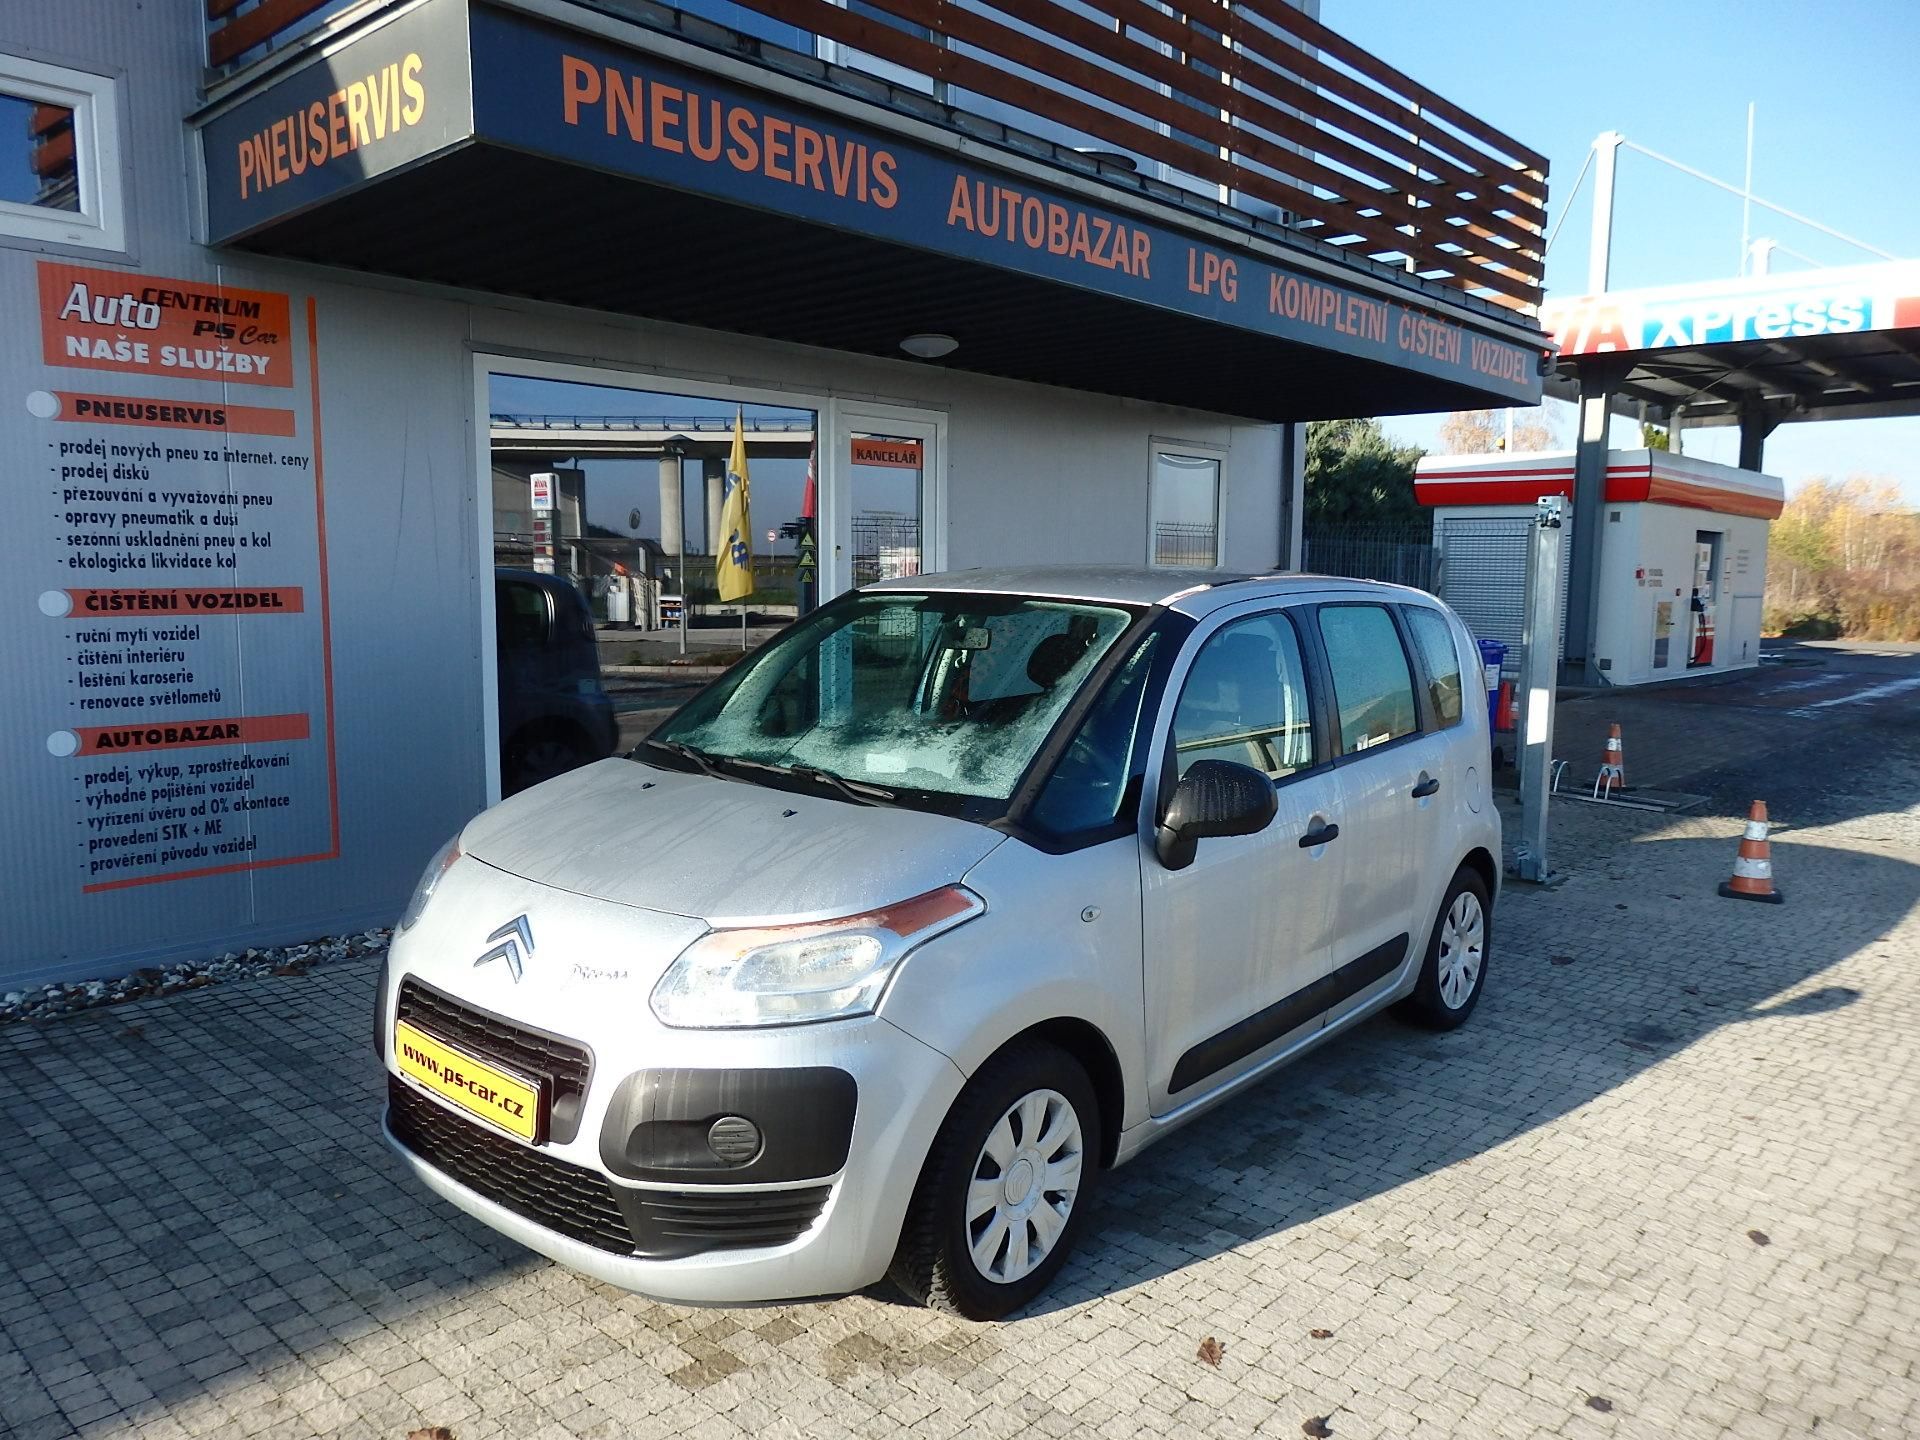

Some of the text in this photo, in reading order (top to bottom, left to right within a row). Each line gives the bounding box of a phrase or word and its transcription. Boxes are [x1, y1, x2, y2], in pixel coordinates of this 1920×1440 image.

[237, 53, 425, 200] PNEUSERVIS
[561, 54, 899, 210] PNEUSERVIS
[947, 175, 1150, 280] AUTOBAZAR
[1188, 247, 1237, 303] LPG
[58, 281, 260, 331] Auto CENTRUM
[193, 320, 279, 345] PS Car
[1269, 273, 1528, 385] KOMPLETNÍ ČIŠTĚNÍ VOZIDEL
[66, 335, 271, 375] NAŠE SLUŽBY
[76, 399, 226, 426] PNEUSERVIS
[60, 439, 309, 470] prodej nových pneu za internet. ceny
[856, 448, 917, 464] KANCELÁŘ
[62, 462, 149, 482] prodej disků
[64, 486, 143, 504] přezouvání
[162, 489, 238, 507] vyvažování
[243, 492, 273, 509] pneu
[65, 512, 116, 528] opravy
[122, 510, 195, 528] pneumatik
[213, 510, 238, 526] duší
[67, 531, 120, 547] sezónní
[126, 531, 199, 547] uskladnění
[204, 533, 235, 550] pneu
[252, 532, 271, 547] kol
[69, 552, 236, 572] ekologická likvidace kol
[85, 590, 282, 611] ČIŠTĚNÍ VOZIDEL
[76, 625, 200, 645] ruční mytí vozidel
[77, 648, 185, 666] čištění interiéru
[79, 668, 194, 687] leštění karoserie
[80, 688, 221, 710] renovace světlometů
[96, 724, 240, 749] AUTOBAZAR
[85, 753, 290, 788] prodej, výkup, zprostředkování
[86, 775, 254, 810] výhodné pojištění vozidel
[88, 795, 290, 831] vyřízení úvěru od 0% akontace
[89, 828, 158, 853] provedení
[163, 824, 188, 841] STK
[204, 819, 222, 834] ME
[90, 836, 257, 874] prověření původu vozidel
[404, 1044, 524, 1118] www.ps-car.cz
